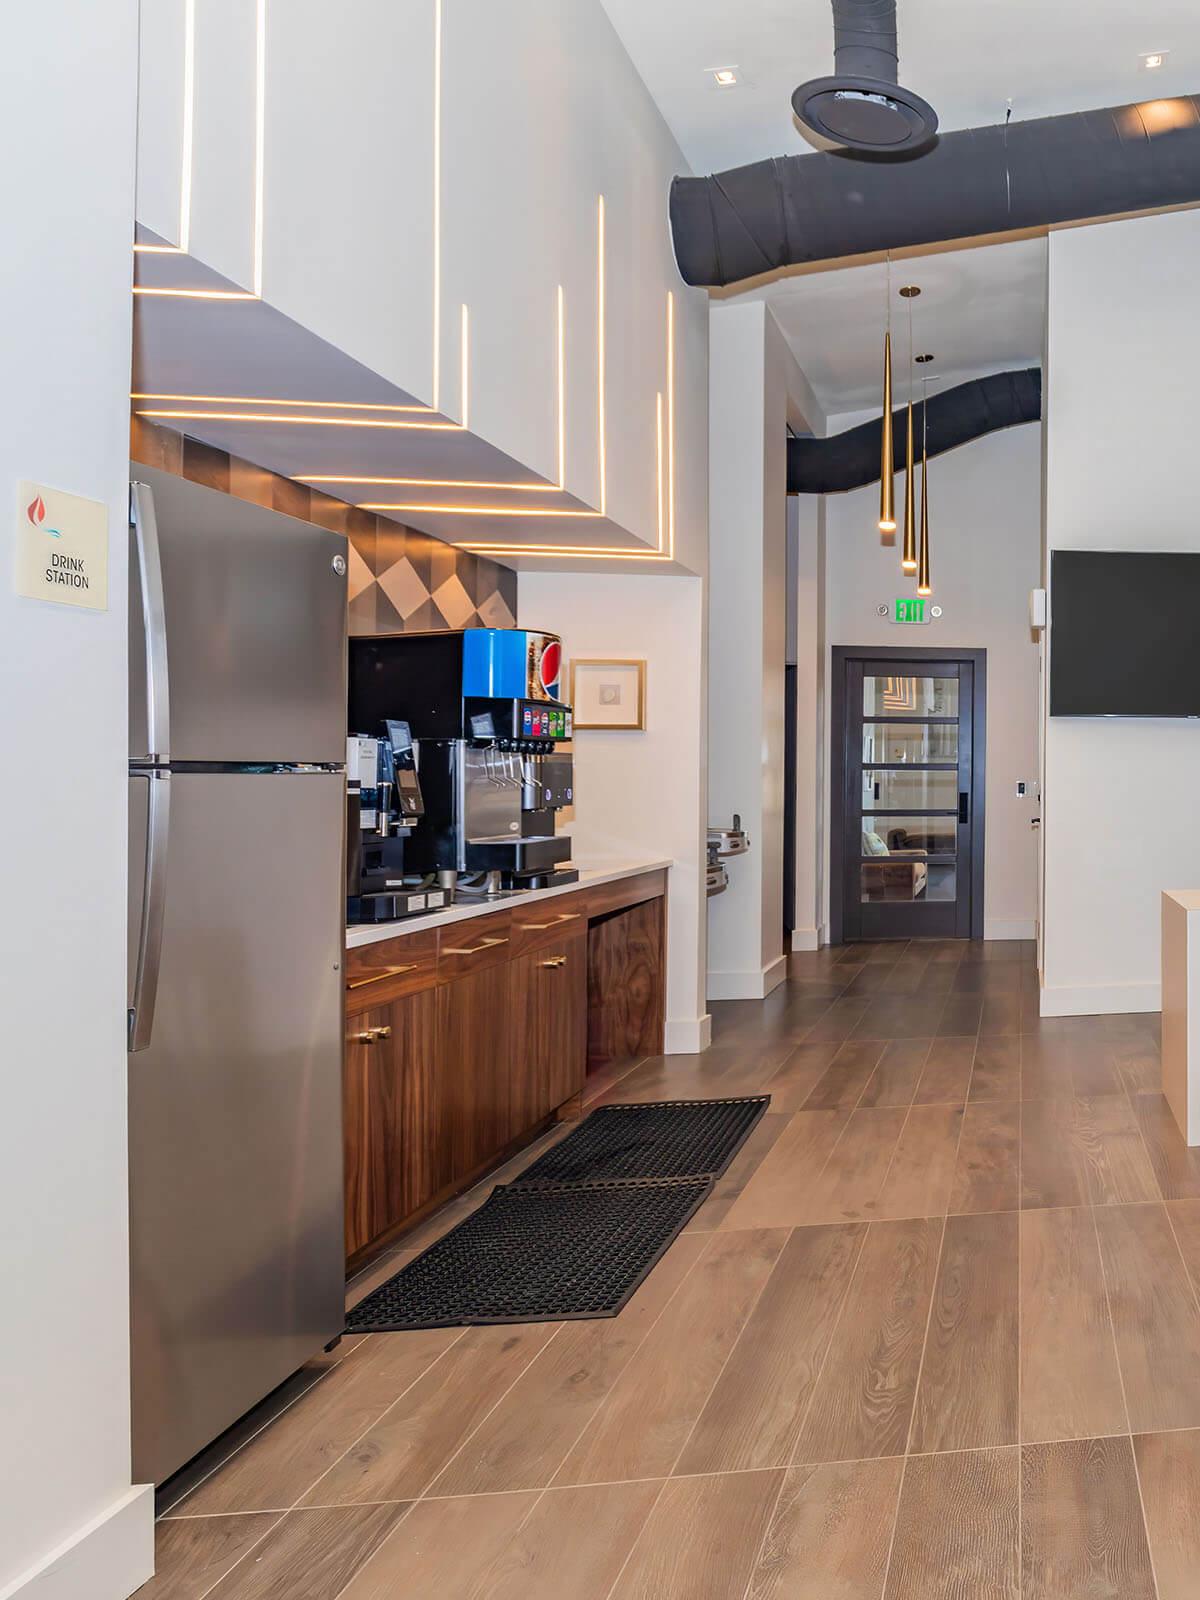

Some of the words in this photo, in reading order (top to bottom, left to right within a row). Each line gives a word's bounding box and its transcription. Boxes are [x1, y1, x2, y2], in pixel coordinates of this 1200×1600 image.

[52, 553, 84, 572] DRINK
[46, 568, 89, 589] STATION
[895, 599, 926, 622] EXIT
